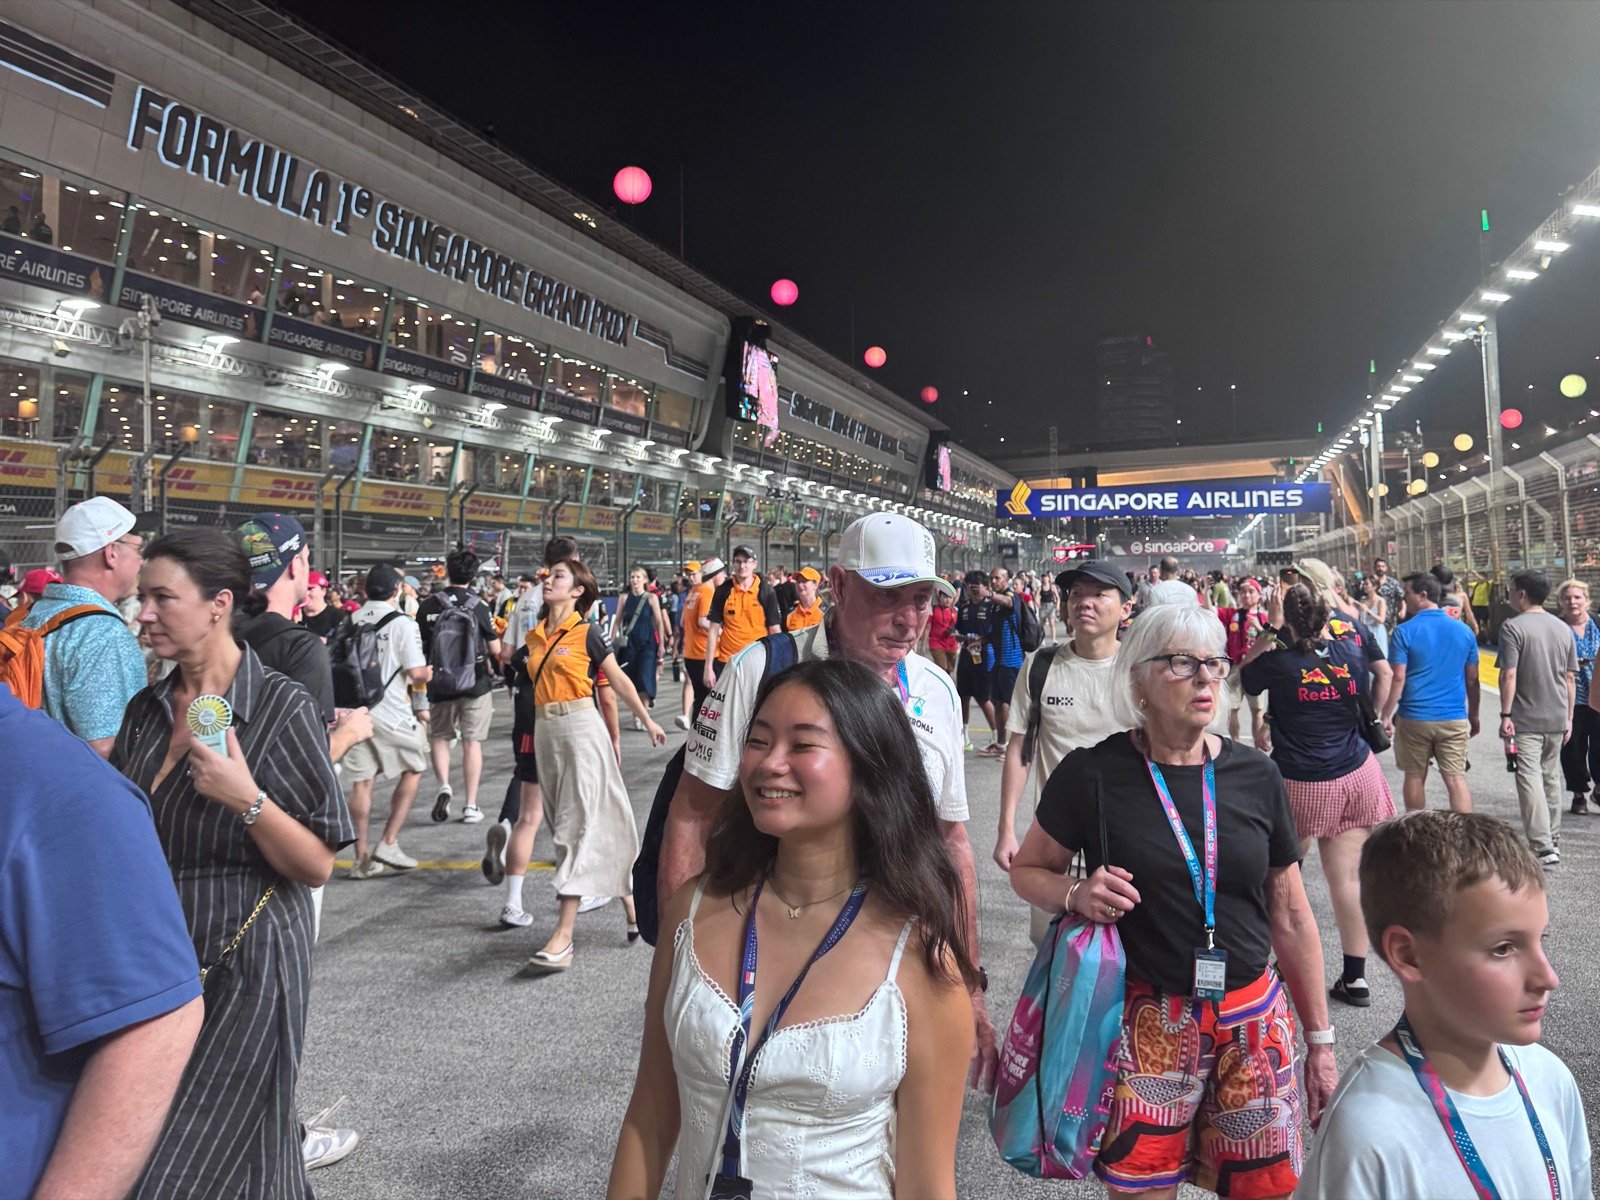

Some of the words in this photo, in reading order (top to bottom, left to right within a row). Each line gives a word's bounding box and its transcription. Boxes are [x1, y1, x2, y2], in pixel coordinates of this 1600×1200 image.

[127, 84, 331, 228] FORMULA
[371, 200, 521, 305] SINGAPORE
[521, 268, 585, 332] GRAND
[584, 297, 631, 348] PRIX
[19, 260, 86, 289] AIRLINES
[121, 287, 194, 317] SINPORE
[194, 306, 244, 330] AIRLINES
[270, 327, 325, 351] SINGAPORE
[325, 342, 364, 362] AIRLINES
[384, 358, 428, 378] SINGAPORE
[1040, 492, 1179, 512] SINGAPORE
[1186, 489, 1304, 509] AIRLINES
[1297, 686, 1330, 702] Red
[698, 742, 713, 758] MIG
[1172, 818, 1195, 860] GRANDSTAND
